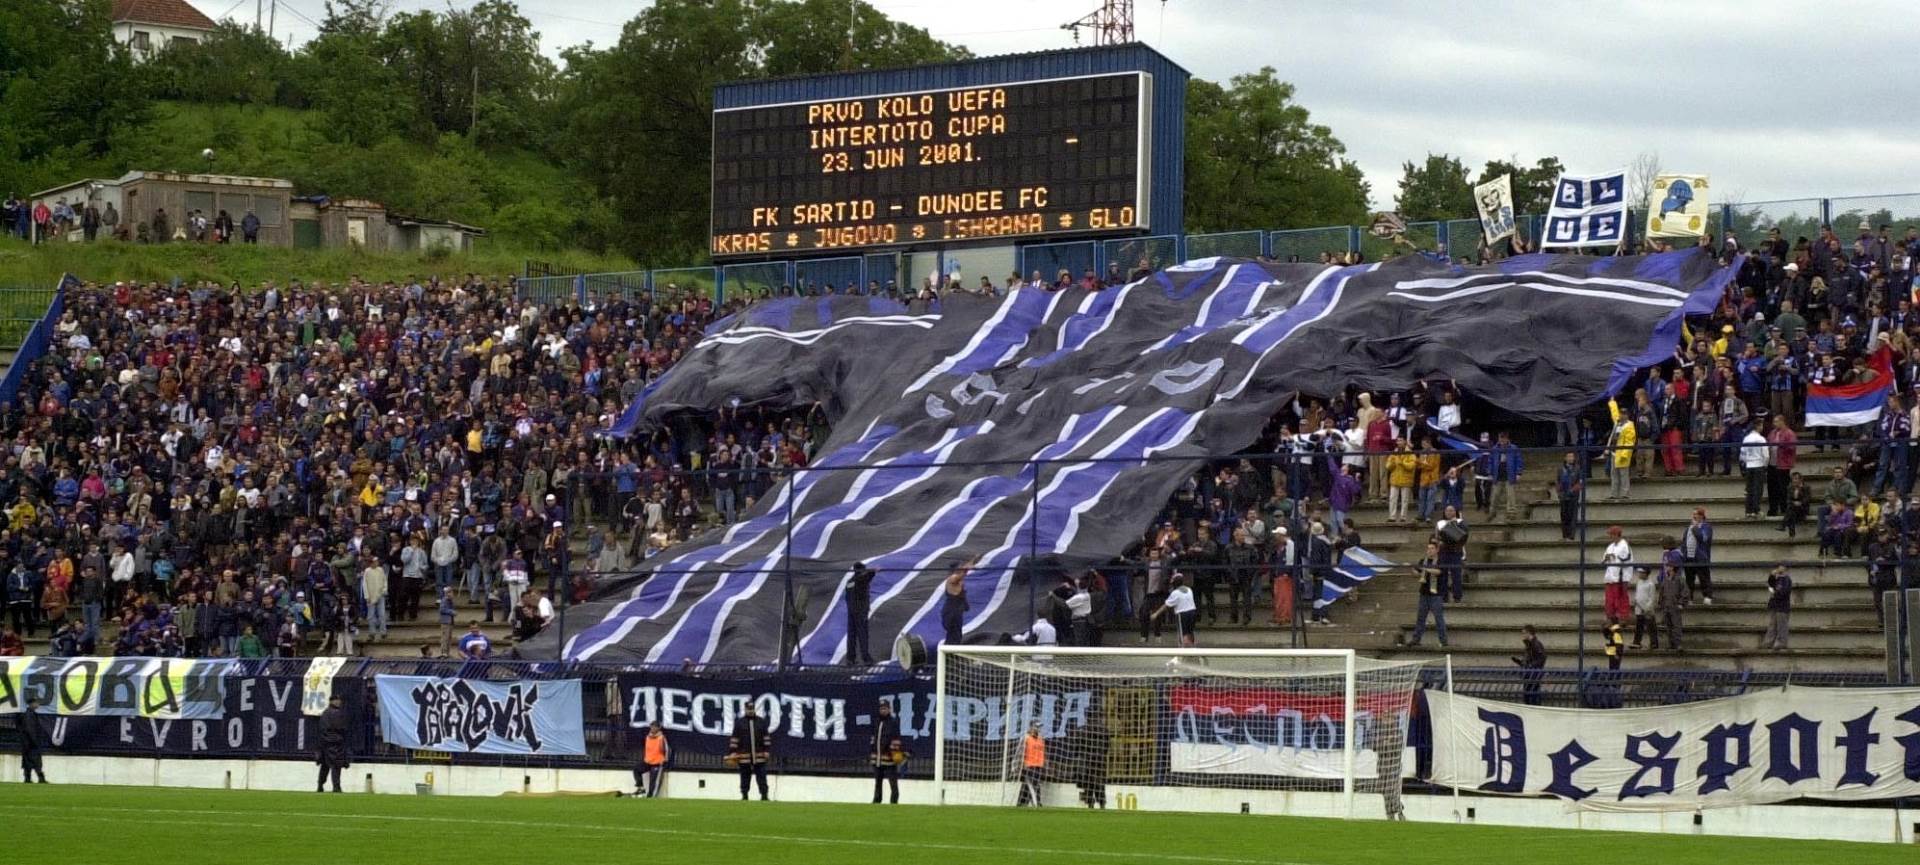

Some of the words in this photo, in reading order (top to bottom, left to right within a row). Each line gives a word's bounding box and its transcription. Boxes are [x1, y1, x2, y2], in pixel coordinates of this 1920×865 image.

[808, 101, 863, 124] PRVO
[877, 95, 933, 119] KOLO
[948, 88, 1006, 112] UEFA
[810, 120, 933, 149] INTERTOTO
[948, 114, 1005, 138] CUPA
[752, 207, 779, 227] FK
[793, 199, 875, 225] SARTID
[918, 190, 1003, 216] DUNDEE
[1019, 187, 1048, 209] FC
[814, 223, 896, 248] JUGOVO
[943, 213, 1043, 240] ISHRANA
[1089, 206, 1134, 229] GLO
[120, 716, 305, 751] EVROPI
[629, 686, 848, 741] ДЕСПОТИ
[1478, 704, 1920, 802] Despoti
